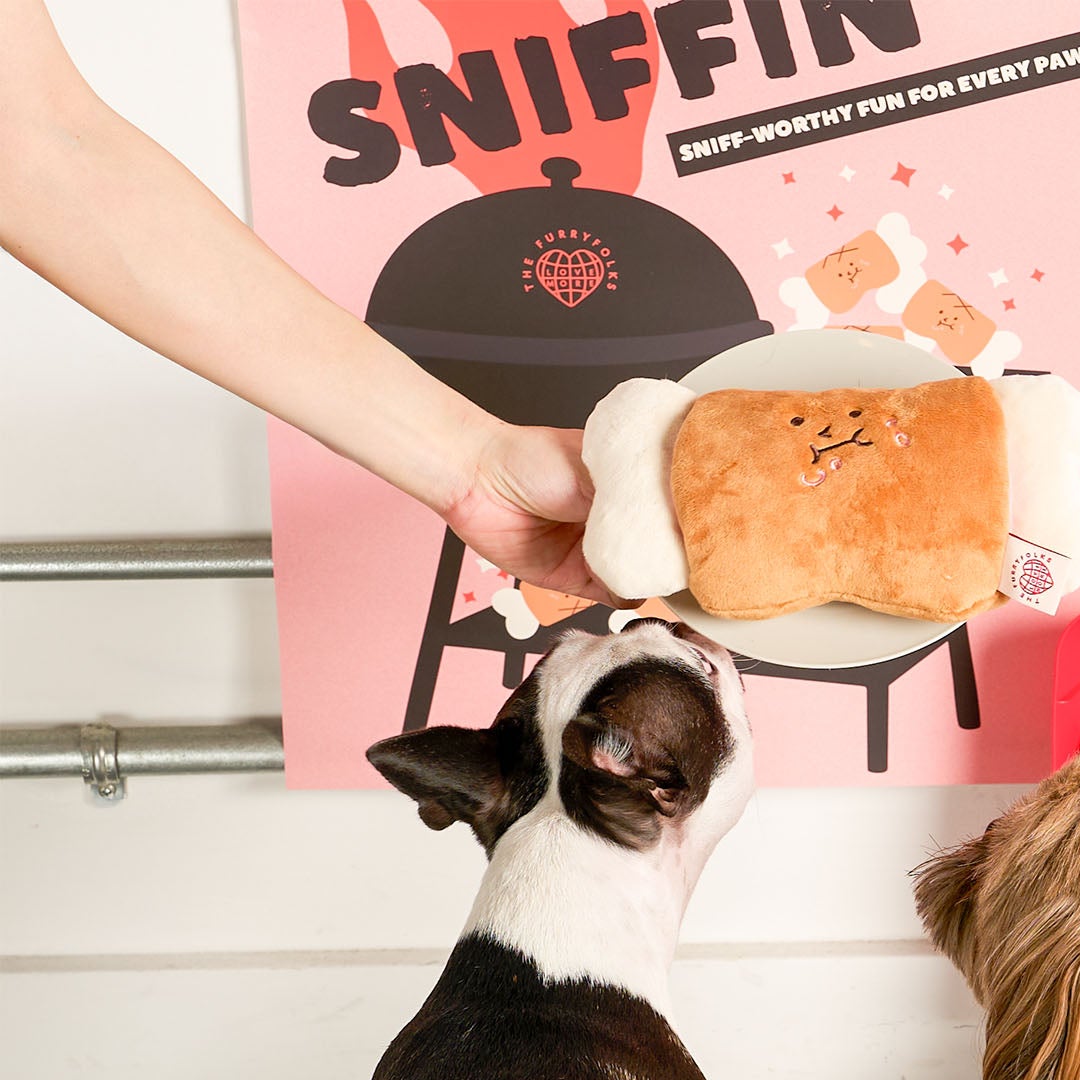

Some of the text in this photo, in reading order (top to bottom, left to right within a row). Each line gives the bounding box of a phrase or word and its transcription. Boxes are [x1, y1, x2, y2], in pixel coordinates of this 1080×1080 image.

[307, 0, 921, 187] SNIFFIN
[679, 104, 852, 162] SNIFF-WORTHY
[856, 91, 907, 118] FUN
[907, 80, 957, 106] FOR
[957, 59, 1031, 93] EVERY
[522, 229, 619, 293] THE FURRYFOLKS
[545, 279, 595, 288] MORE
[546, 268, 595, 277] LOVE
